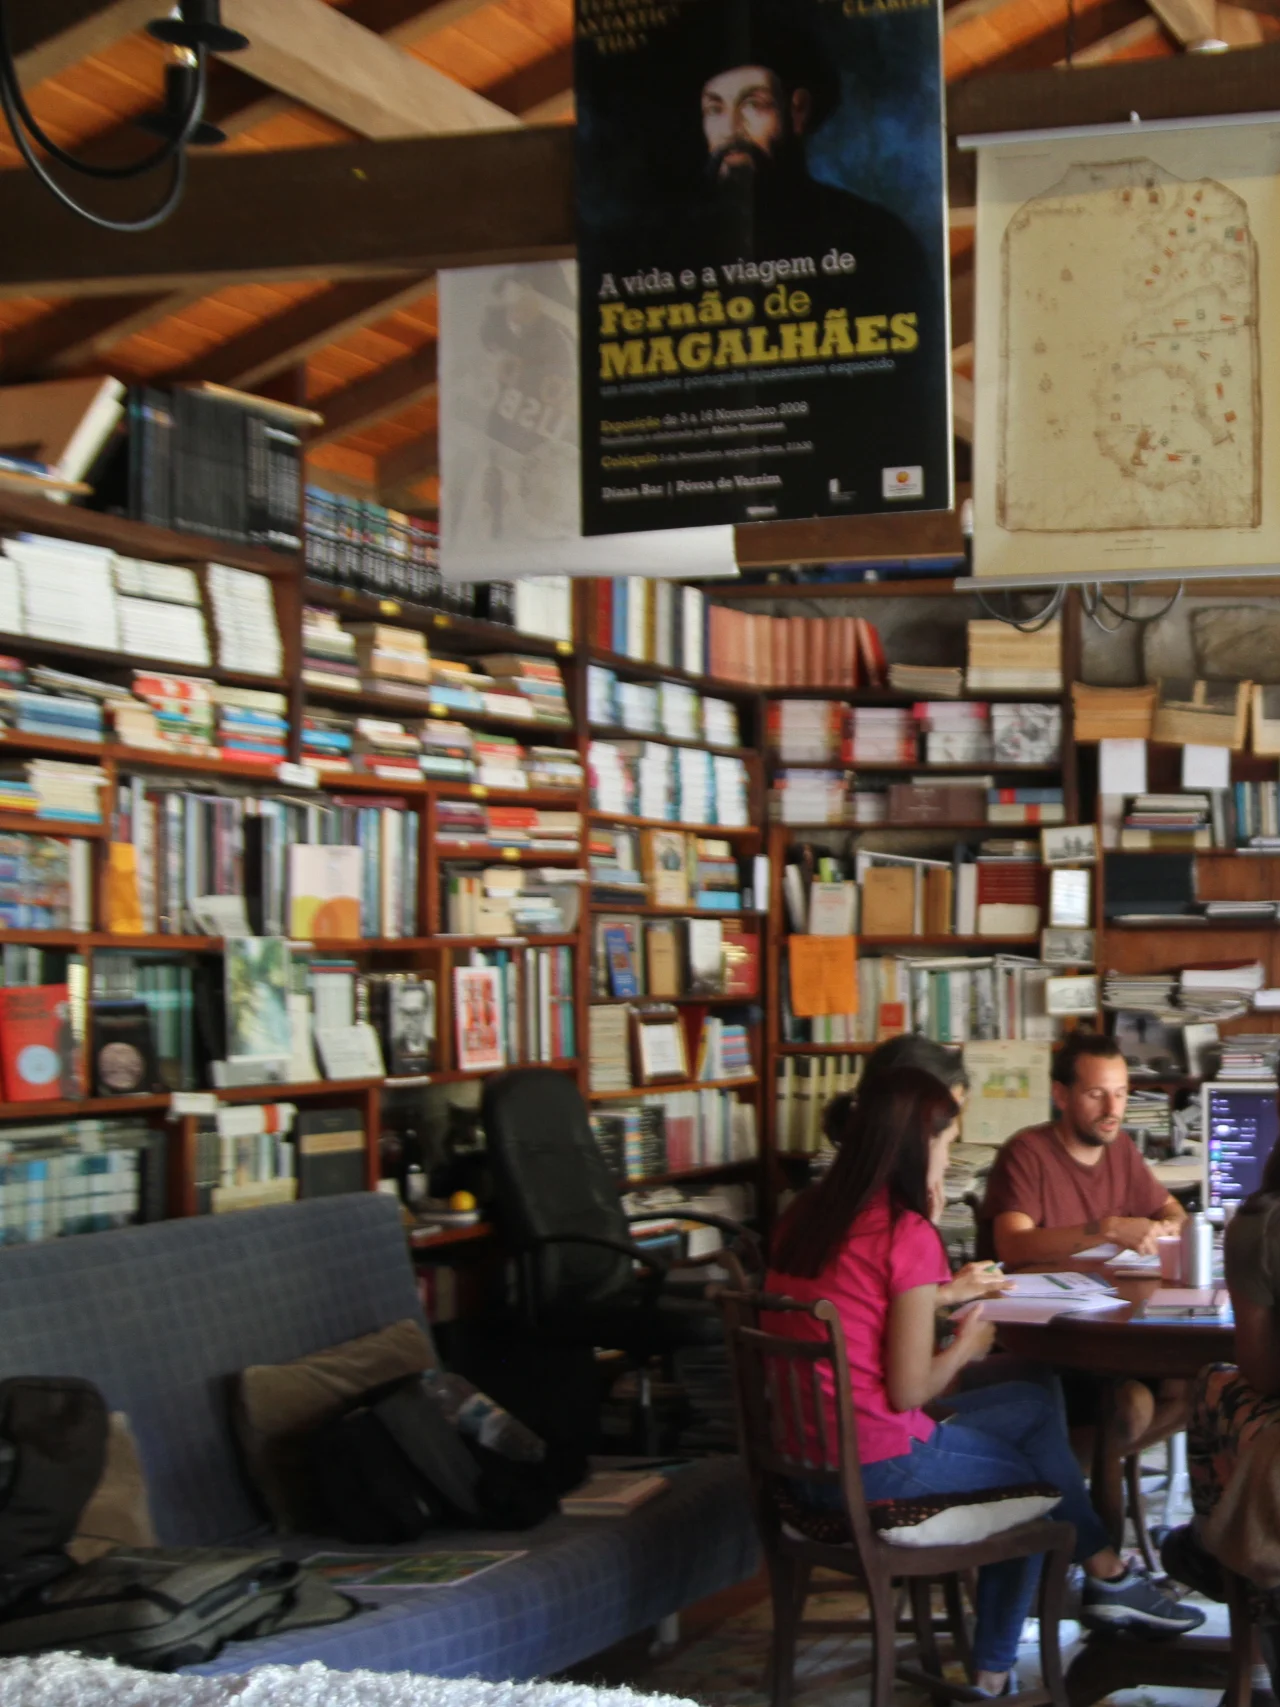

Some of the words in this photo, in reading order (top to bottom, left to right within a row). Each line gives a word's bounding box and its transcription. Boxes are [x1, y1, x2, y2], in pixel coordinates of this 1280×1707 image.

[599, 273, 619, 297] A
[622, 268, 675, 294] vida
[680, 270, 696, 288] e
[702, 269, 717, 287] a
[722, 257, 816, 285] viagem
[822, 249, 856, 274] de
[599, 289, 754, 336] Fernão
[765, 285, 811, 318] de
[599, 309, 919, 381] MAGALHÃES
[829, 358, 896, 378] esquecido
[662, 413, 678, 425] de
[716, 404, 776, 419] Novembro
[601, 485, 640, 500] Diana
[641, 483, 664, 497] Bar
[676, 477, 714, 494] Póvoa
[716, 476, 733, 490] de
[733, 472, 783, 489] Varzim
